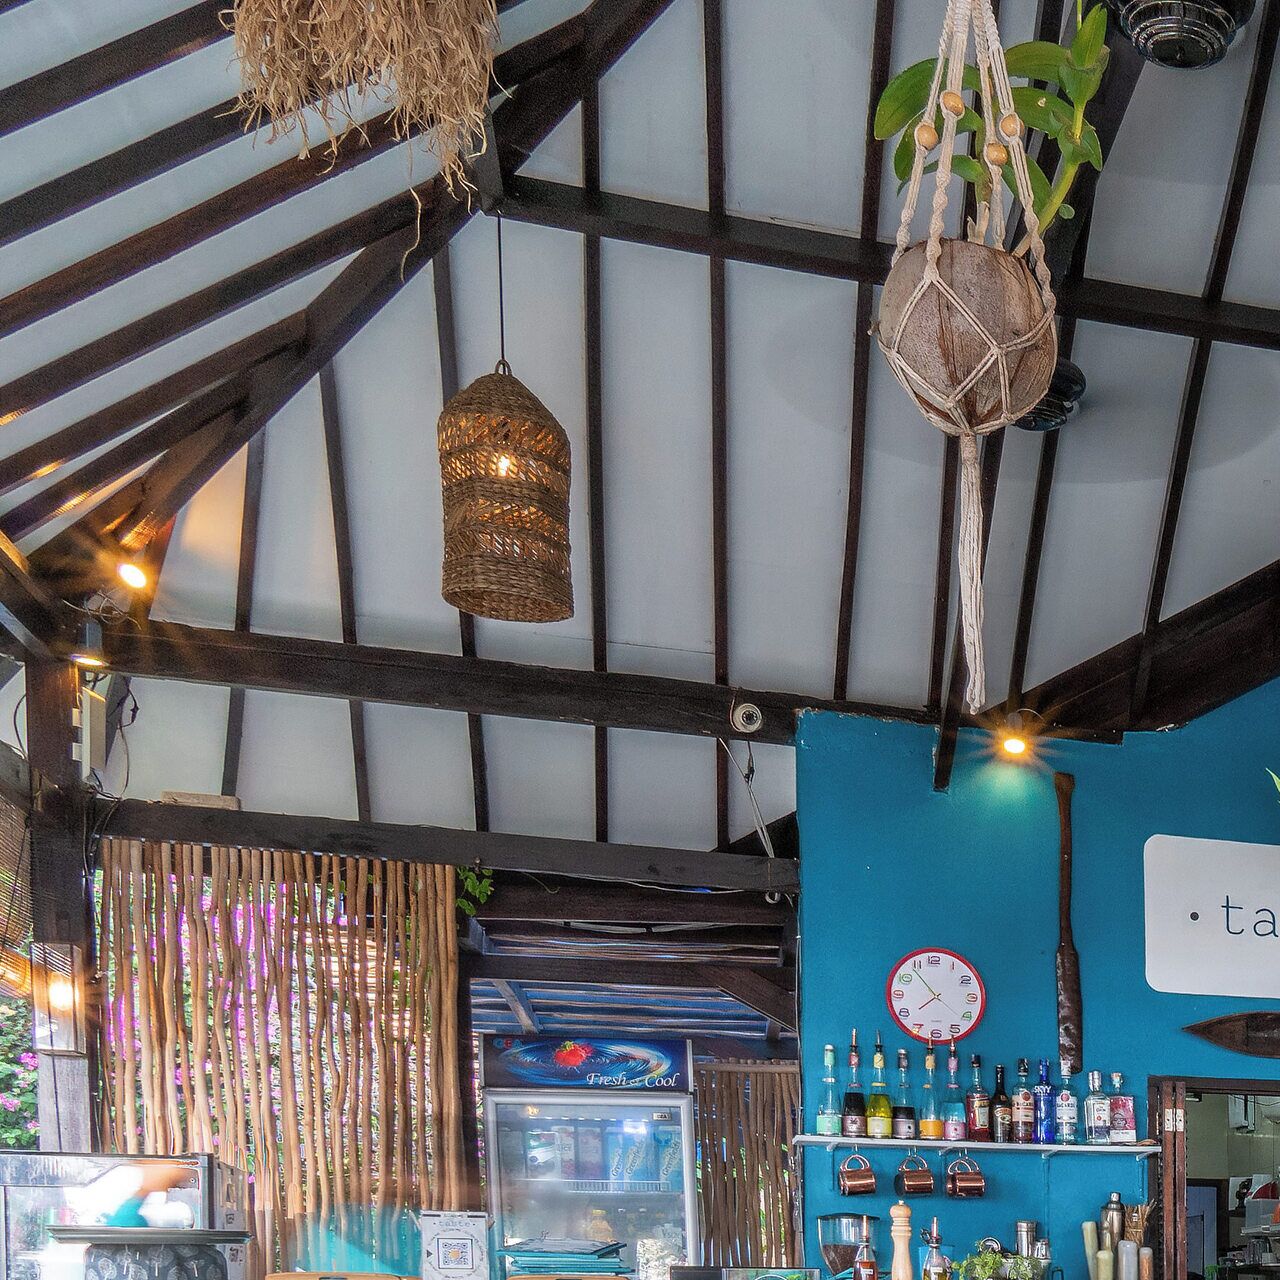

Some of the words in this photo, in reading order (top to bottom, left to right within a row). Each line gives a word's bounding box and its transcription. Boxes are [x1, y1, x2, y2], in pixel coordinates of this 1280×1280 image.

[928, 955, 941, 965] 12
[960, 975, 972, 985] 2
[899, 1008, 910, 1017] 8
[931, 1029, 942, 1038] 6
[949, 1024, 961, 1034] 5
[586, 1072, 627, 1087] Fresh
[645, 1072, 681, 1088] Cool
